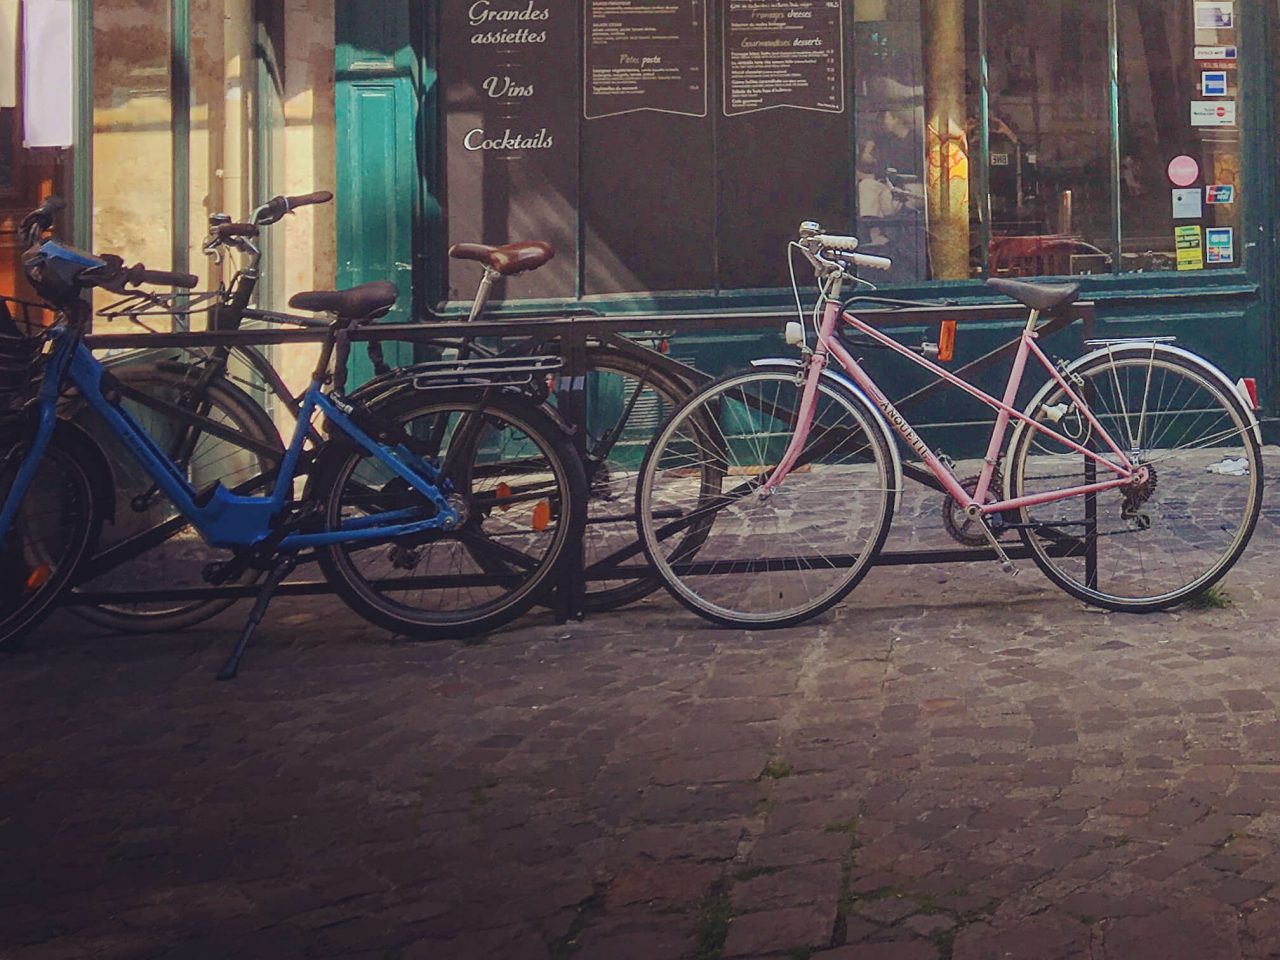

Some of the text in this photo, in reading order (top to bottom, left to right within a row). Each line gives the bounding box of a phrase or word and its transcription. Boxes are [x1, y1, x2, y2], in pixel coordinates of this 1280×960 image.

[468, 0, 549, 26] Grandes
[470, 28, 546, 45] assiettes
[483, 76, 534, 98] Vins
[463, 129, 553, 152] Cocktails
